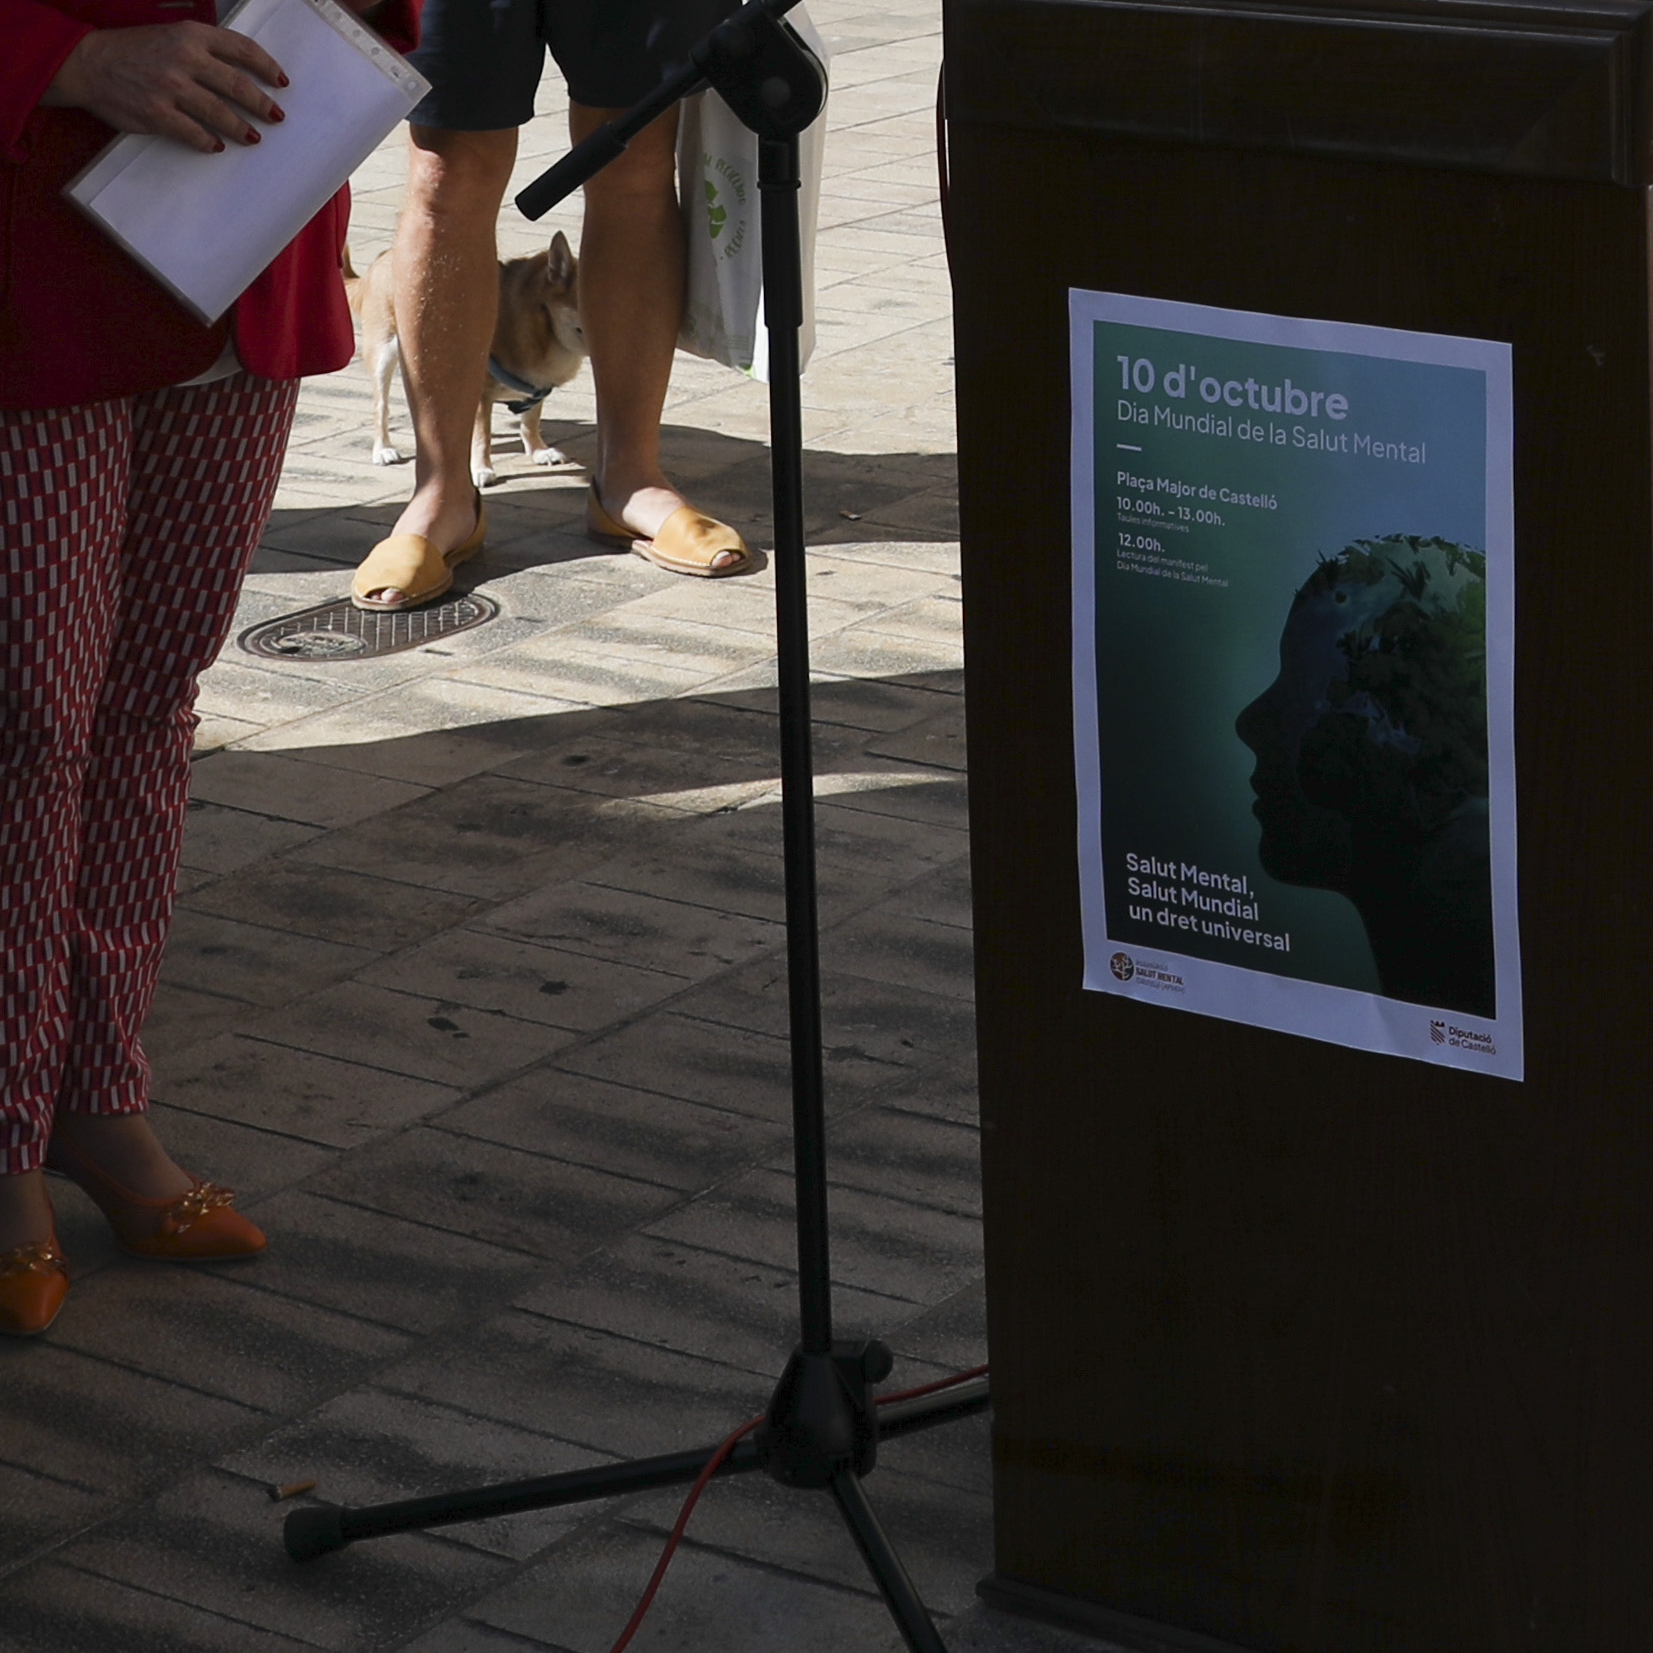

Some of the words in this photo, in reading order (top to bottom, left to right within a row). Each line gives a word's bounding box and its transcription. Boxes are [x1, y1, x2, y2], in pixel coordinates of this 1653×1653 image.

[1117, 355, 1155, 393] 10
[1163, 363, 1350, 421] d'octubre
[1117, 399, 1149, 424] Dia
[1154, 405, 1233, 438] Mundial
[1237, 419, 1265, 442] de
[1269, 422, 1287, 445] la
[1292, 426, 1348, 453] Salut
[1354, 433, 1427, 465] Mental
[1116, 471, 1154, 493] Plaça
[1156, 477, 1197, 498] Major
[1199, 484, 1217, 500] de
[1219, 488, 1278, 510] Castelló
[1116, 496, 1165, 517] 10.00h.
[1177, 506, 1226, 527] 13.00h.
[1116, 549, 1147, 561] Lectura
[1118, 532, 1166, 553] 12.00h.
[1116, 560, 1130, 571] Dia
[1131, 563, 1160, 577] Mundial
[1161, 567, 1172, 578] de
[1172, 569, 1180, 580] la
[1180, 571, 1201, 583] Salut
[1201, 574, 1229, 588] Mental
[1126, 852, 1177, 879] Salut
[1180, 862, 1255, 900] Mental,
[1127, 877, 1178, 904] Salut
[1181, 887, 1260, 922] Mundial
[1128, 904, 1153, 923] un
[1156, 907, 1199, 932] dret
[1201, 919, 1291, 953] universal
[1448, 1026, 1492, 1044] Diputació
[1448, 1037, 1461, 1048] de
[1461, 1039, 1497, 1055] Castelló
